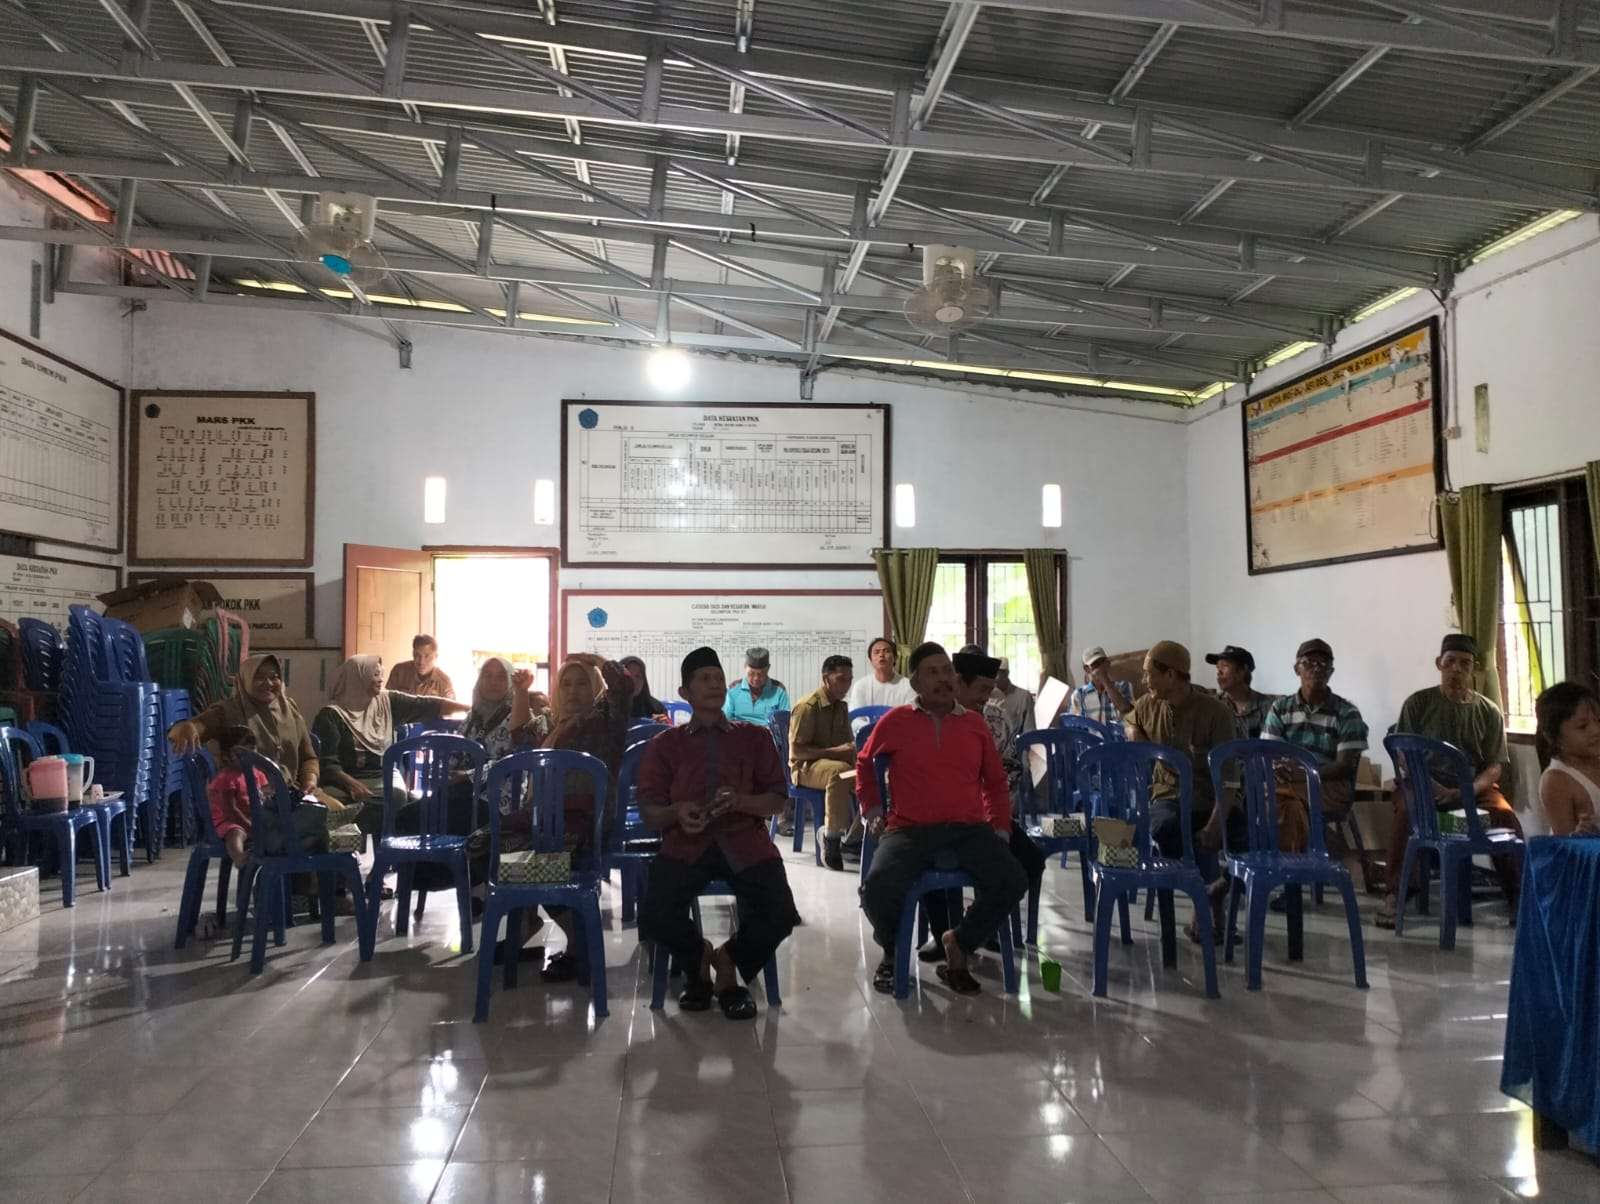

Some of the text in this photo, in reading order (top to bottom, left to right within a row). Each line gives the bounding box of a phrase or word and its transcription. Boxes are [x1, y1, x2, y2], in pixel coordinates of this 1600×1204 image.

[196, 416, 256, 425] MARS PKK
[244, 599, 260, 610] PKK
